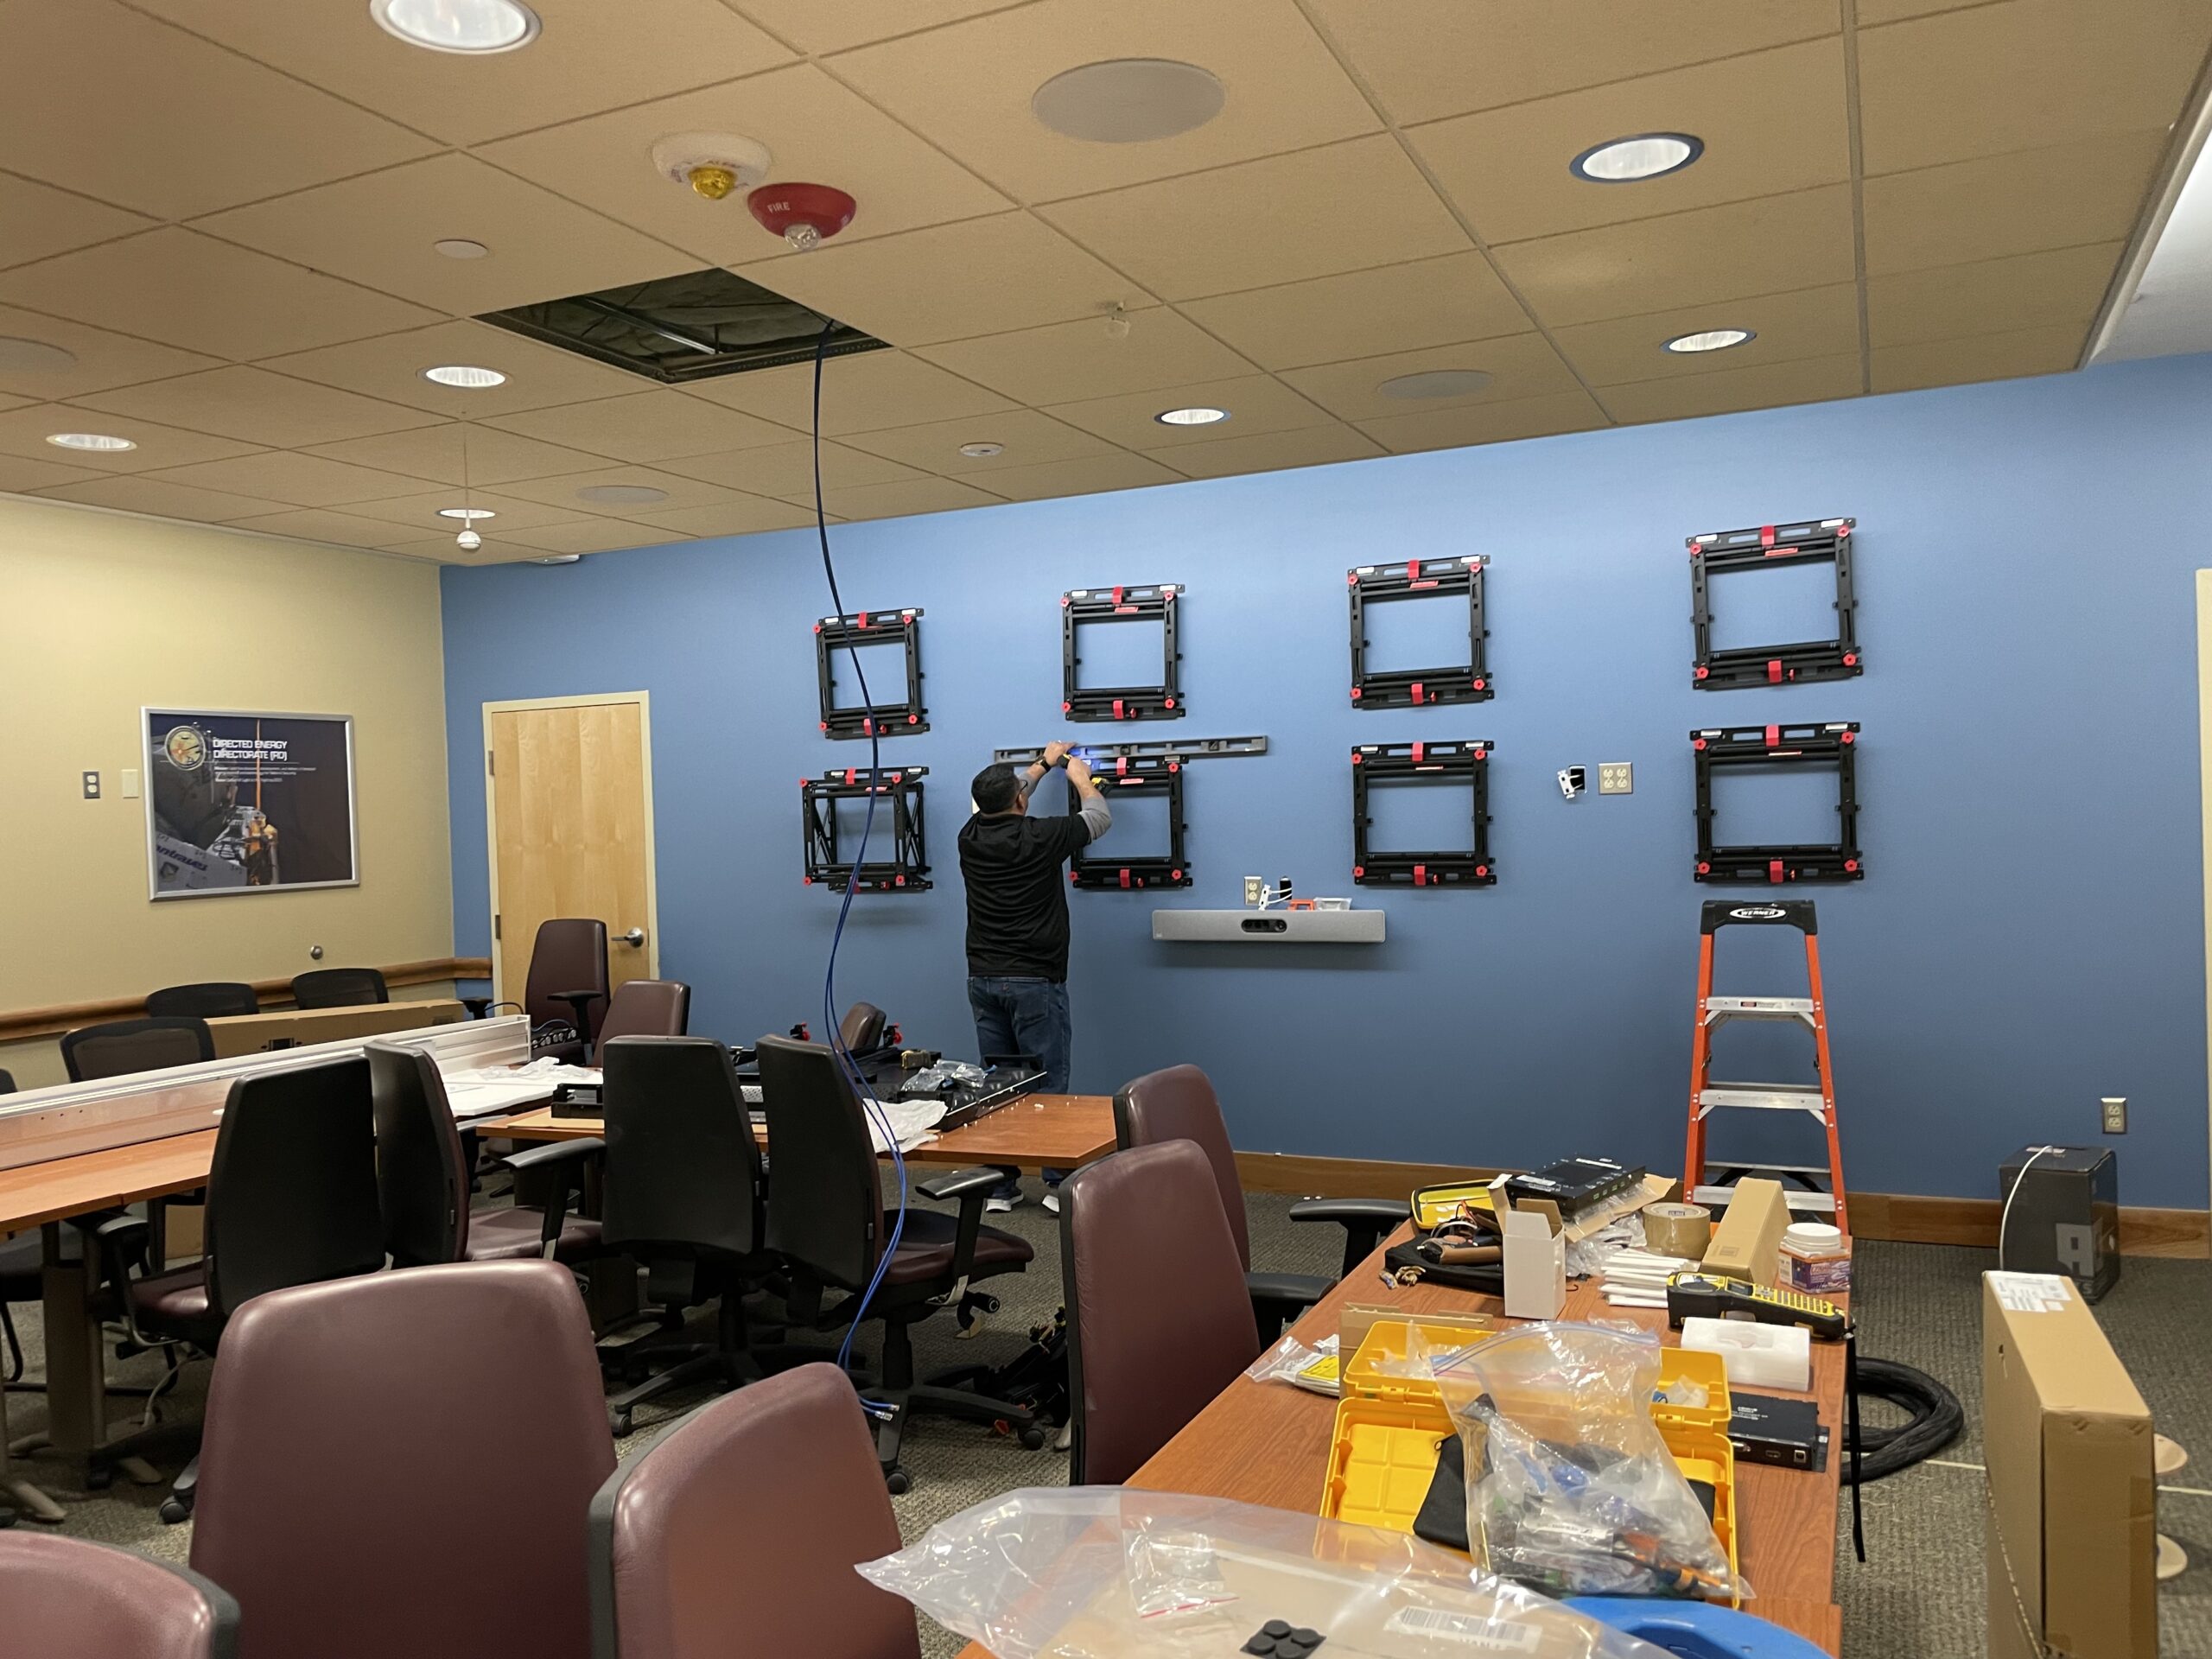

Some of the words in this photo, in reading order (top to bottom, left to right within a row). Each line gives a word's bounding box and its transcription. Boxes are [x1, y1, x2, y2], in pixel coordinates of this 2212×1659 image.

[767, 201, 791, 213] FIRE
[213, 739, 253, 748] DIRECTED
[254, 741, 288, 749] ENERGY
[213, 749, 269, 760] DIRECTORATE
